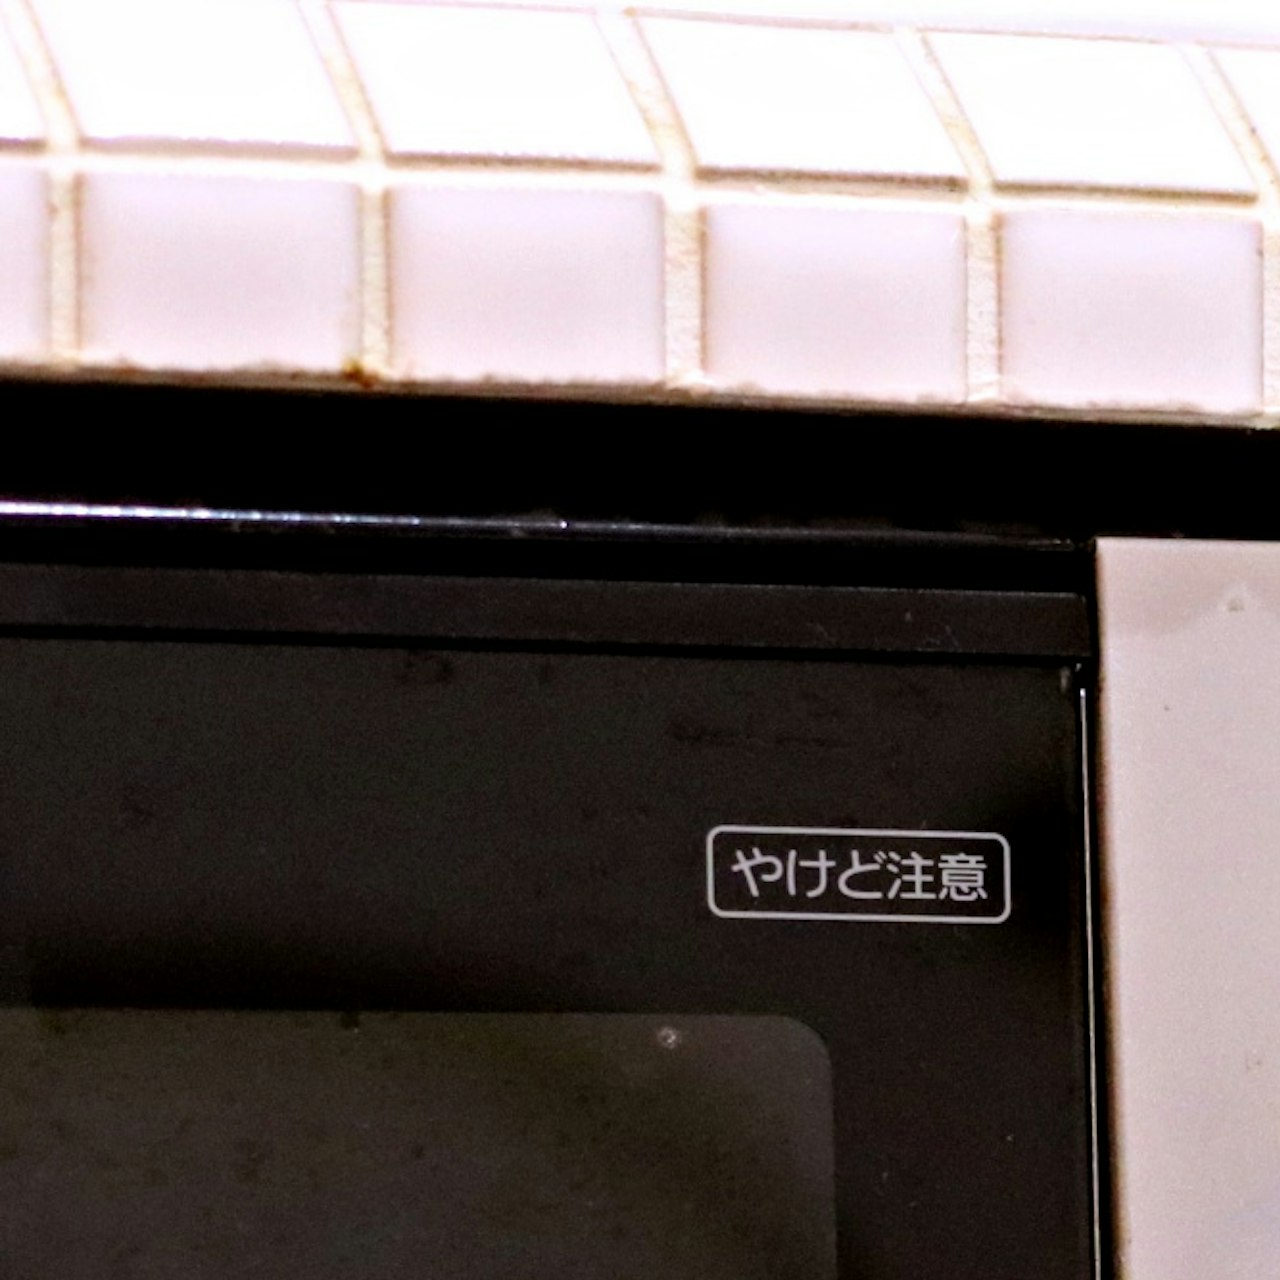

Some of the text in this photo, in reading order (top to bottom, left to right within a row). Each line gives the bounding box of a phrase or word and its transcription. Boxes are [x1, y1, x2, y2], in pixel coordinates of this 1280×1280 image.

[731, 847, 988, 901] やけど注意
